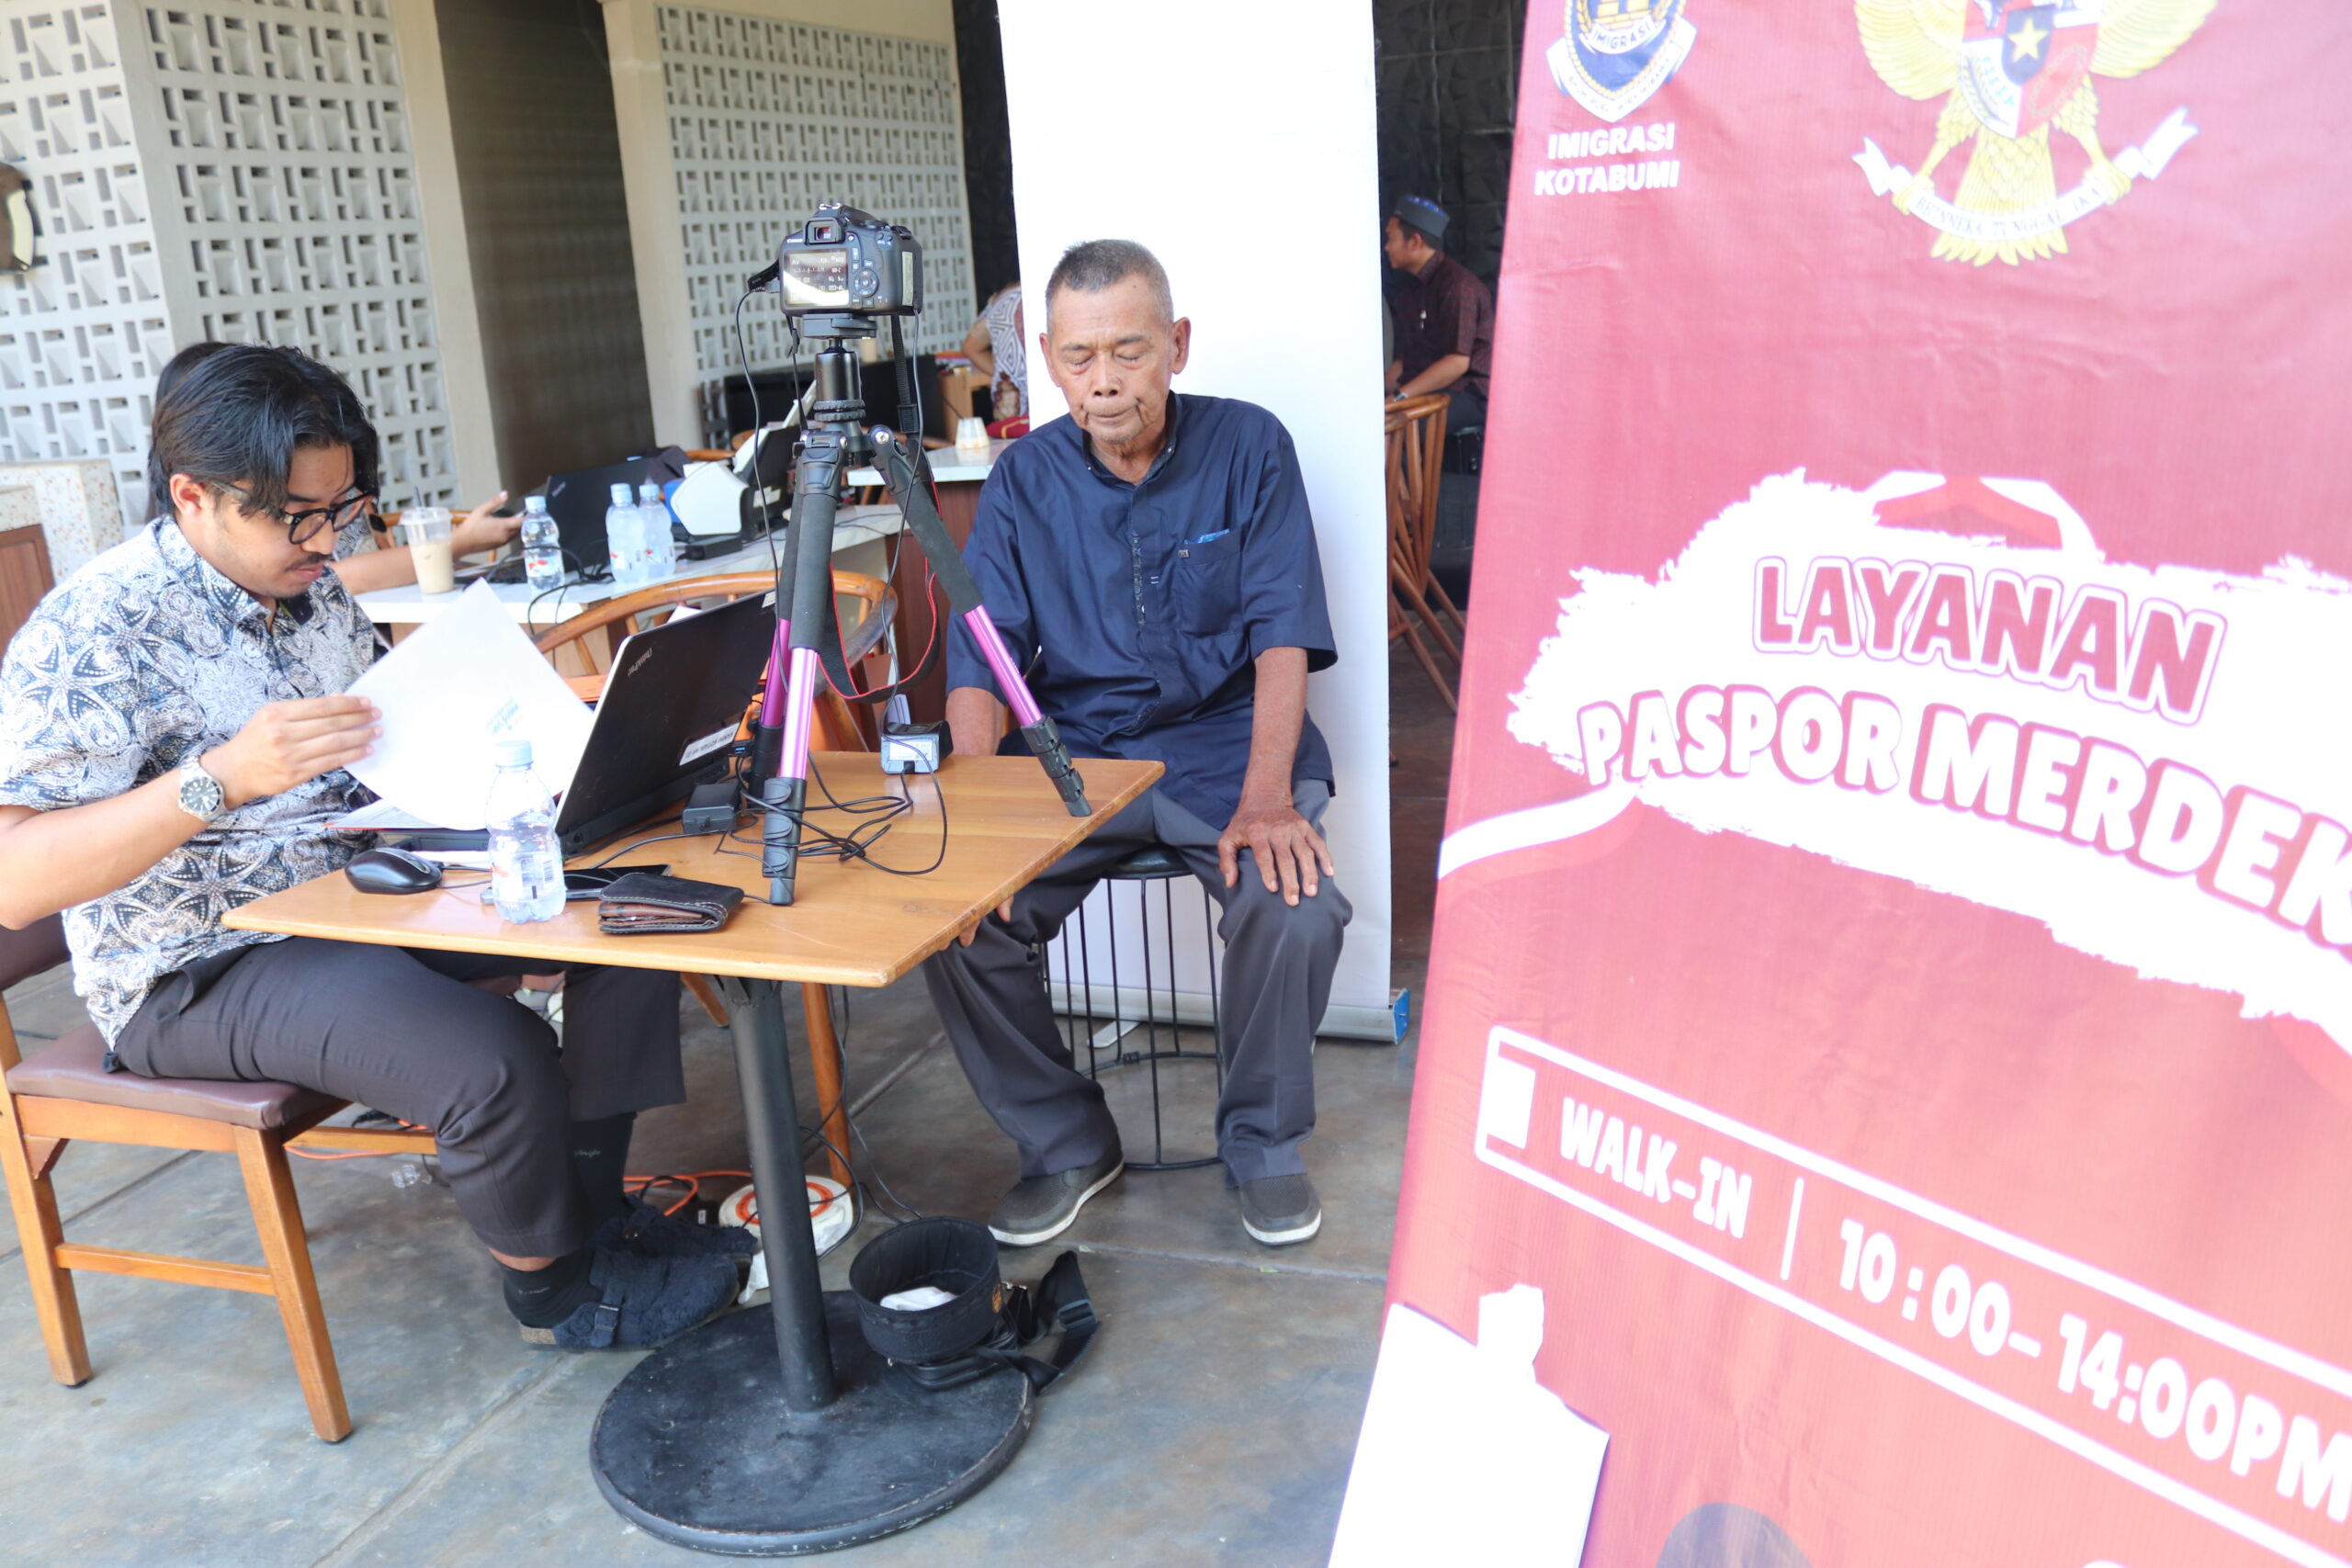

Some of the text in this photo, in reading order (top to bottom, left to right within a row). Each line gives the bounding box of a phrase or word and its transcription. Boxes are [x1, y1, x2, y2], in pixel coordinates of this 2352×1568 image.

[1592, 21, 1652, 50] IMIGRASI
[1533, 160, 1680, 196] KOTABUMI
[1547, 122, 1676, 160] IMIGRASI
[1754, 557, 2227, 726] LAYANAN
[1577, 684, 2352, 961] PASPOR MERDEK
[1560, 1096, 1752, 1239] WALK-IN
